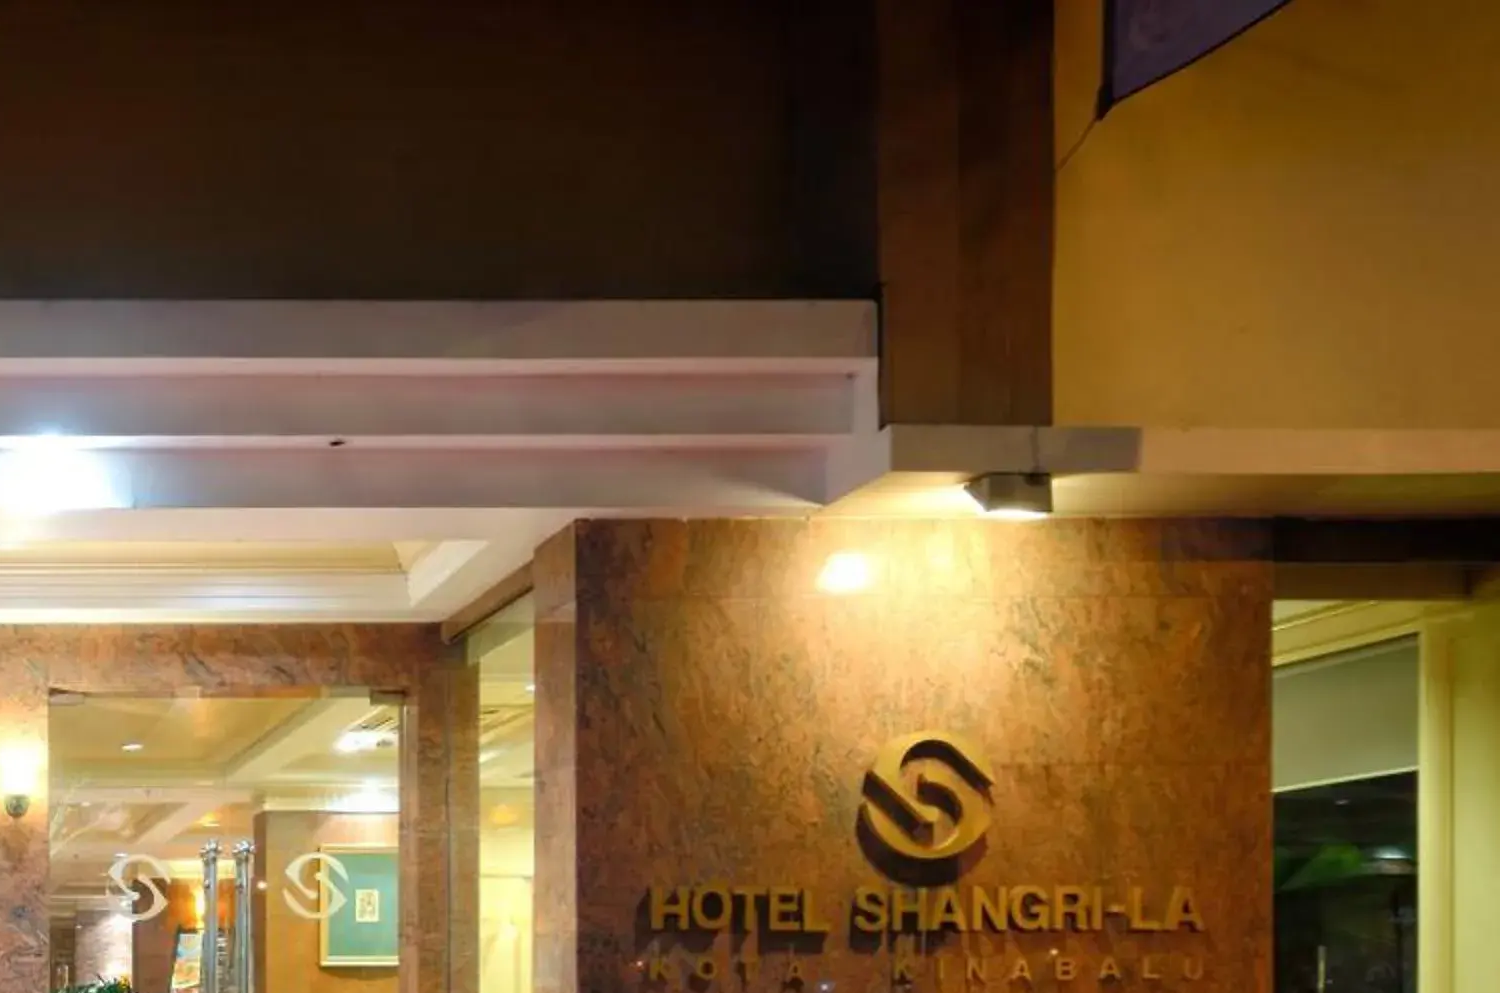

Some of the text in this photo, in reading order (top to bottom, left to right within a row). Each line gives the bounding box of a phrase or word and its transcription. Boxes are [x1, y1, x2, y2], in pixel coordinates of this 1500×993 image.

[650, 884, 1204, 932] HOTEL SHANGRI-LA
[651, 956, 1204, 982] KOTA KINABALU
